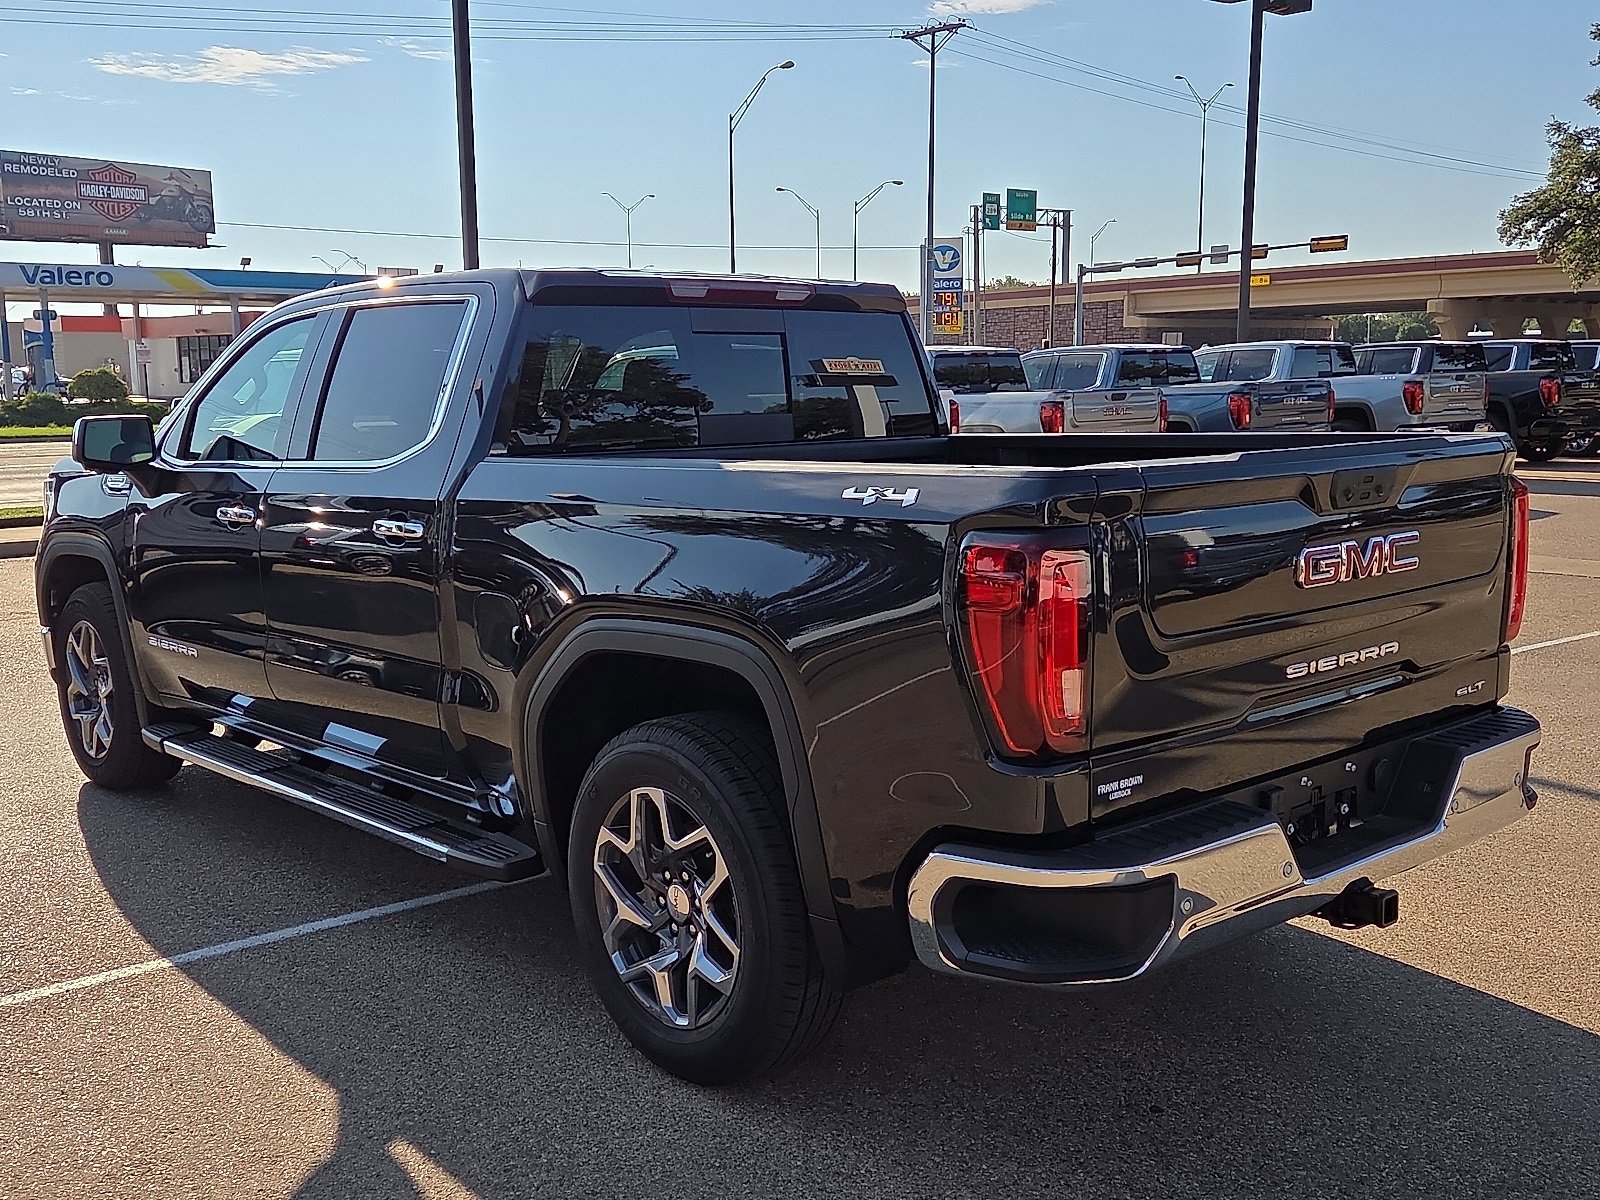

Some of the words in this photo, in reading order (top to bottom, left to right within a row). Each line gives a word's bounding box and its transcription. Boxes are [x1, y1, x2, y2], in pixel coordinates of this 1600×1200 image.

[20, 154, 60, 167] NEWLY
[4, 163, 78, 178] REMODELED
[92, 171, 134, 184] MOTOR
[80, 183, 146, 201] HARLEY-DAVIDSON
[7, 196, 62, 208] LOCATED
[64, 201, 81, 210] ON
[95, 201, 134, 217] CYCLES
[18, 208, 51, 218] 58TH
[54, 210, 70, 219] ST.
[19, 265, 114, 287] Valero
[933, 280, 961, 288] alero
[1294, 530, 1420, 588] GMC
[148, 636, 198, 658] SIERRA
[1285, 641, 1400, 679] SIERRA
[1455, 680, 1486, 697] SLT
[1097, 781, 1119, 796] FRANK
[1120, 774, 1143, 789] BROWN
